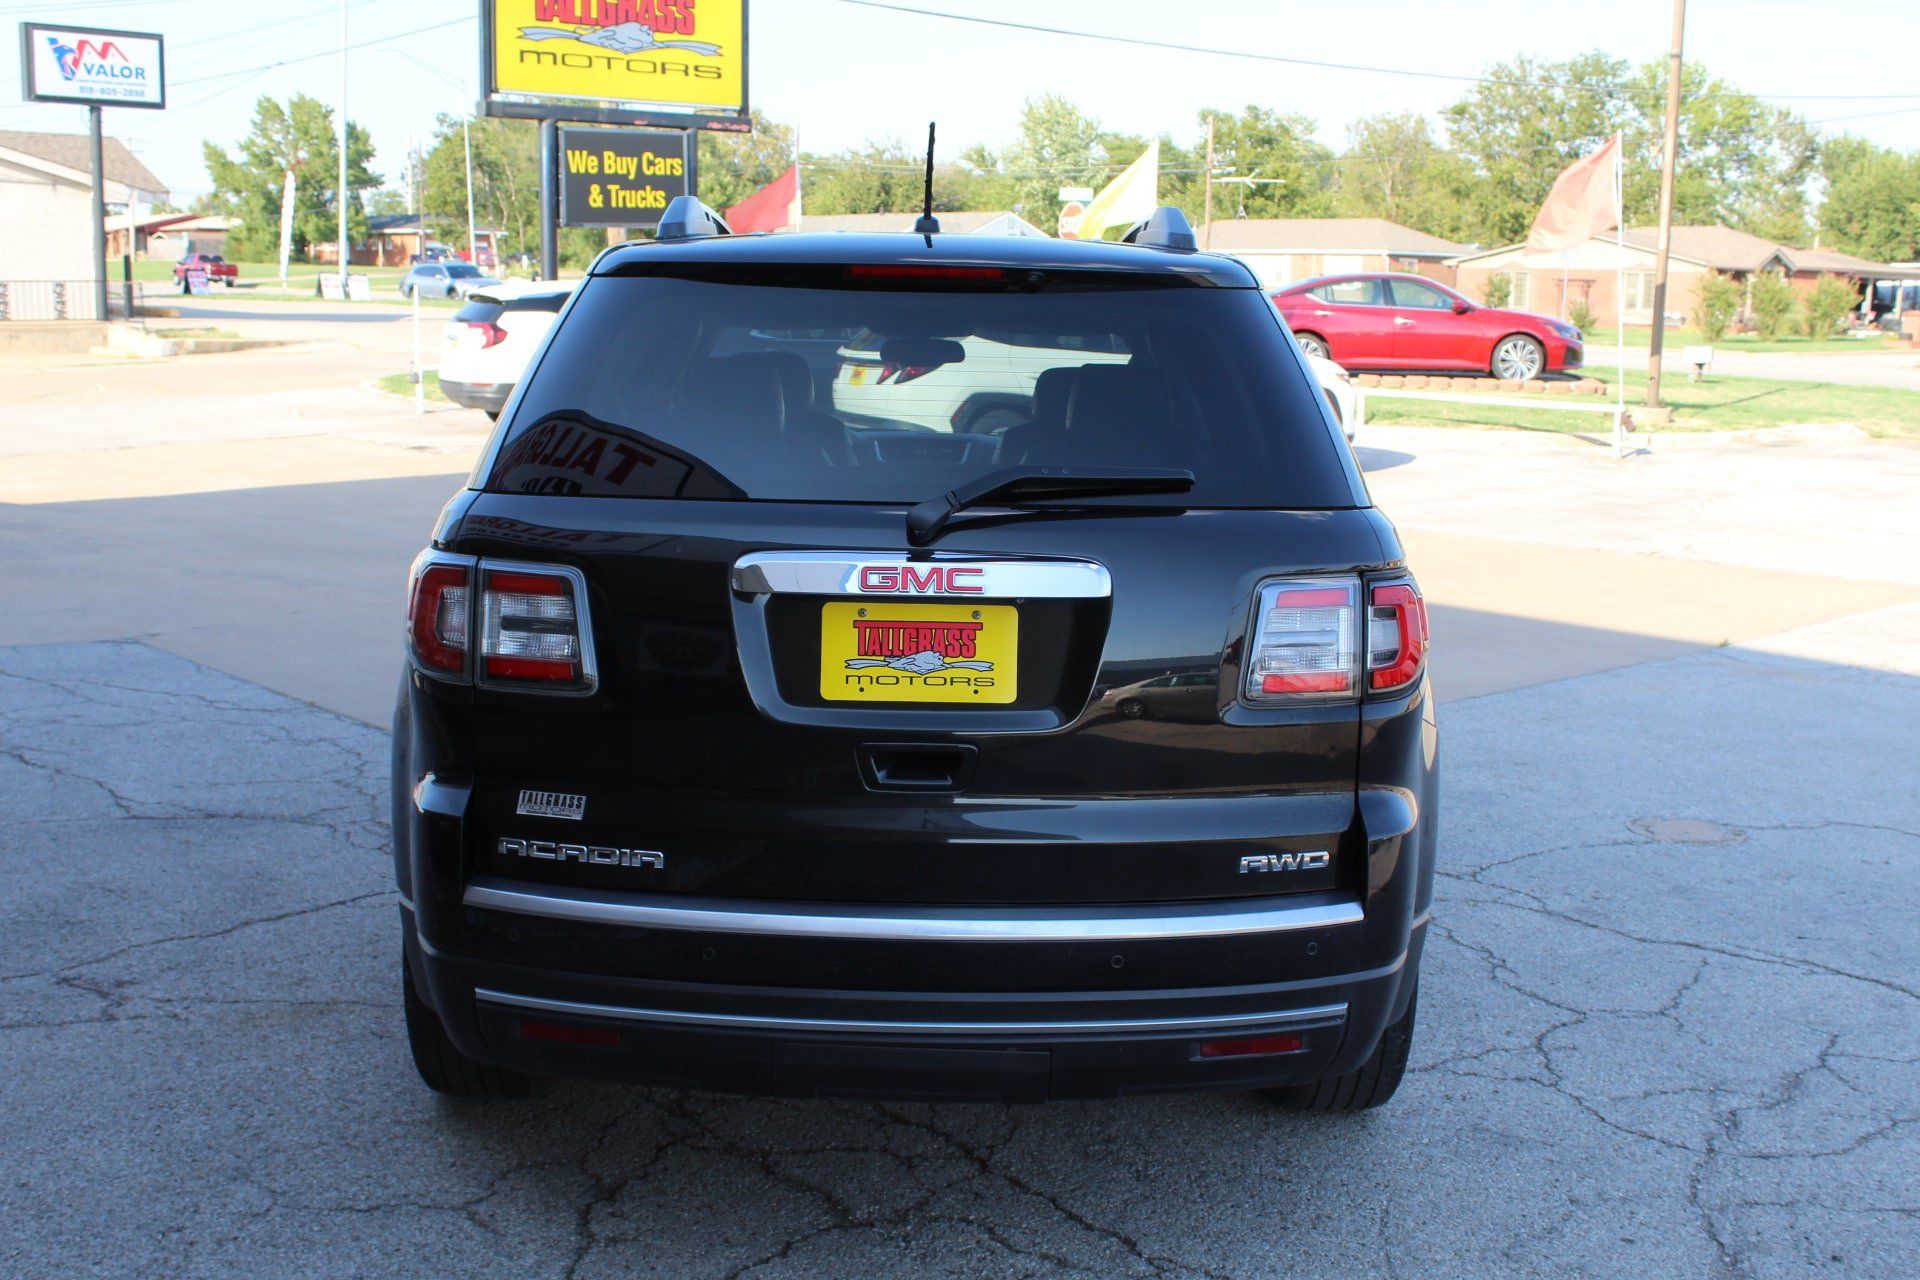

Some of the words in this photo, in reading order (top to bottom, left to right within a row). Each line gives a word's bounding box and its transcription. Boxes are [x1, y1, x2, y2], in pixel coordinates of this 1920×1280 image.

[83, 62, 146, 80] VALOR
[520, 49, 722, 80] MOTORS
[567, 150, 598, 174] We
[603, 151, 638, 180] Buy
[642, 151, 683, 176] Cars
[588, 184, 603, 208] &
[607, 184, 666, 208] Trucks
[858, 566, 985, 593] GMC
[853, 620, 983, 658] TALLGRASS
[845, 674, 995, 687] MOTORS
[521, 790, 583, 809] TALLGRASS
[498, 837, 664, 869] ACADIA
[1239, 851, 1330, 873] AWD
